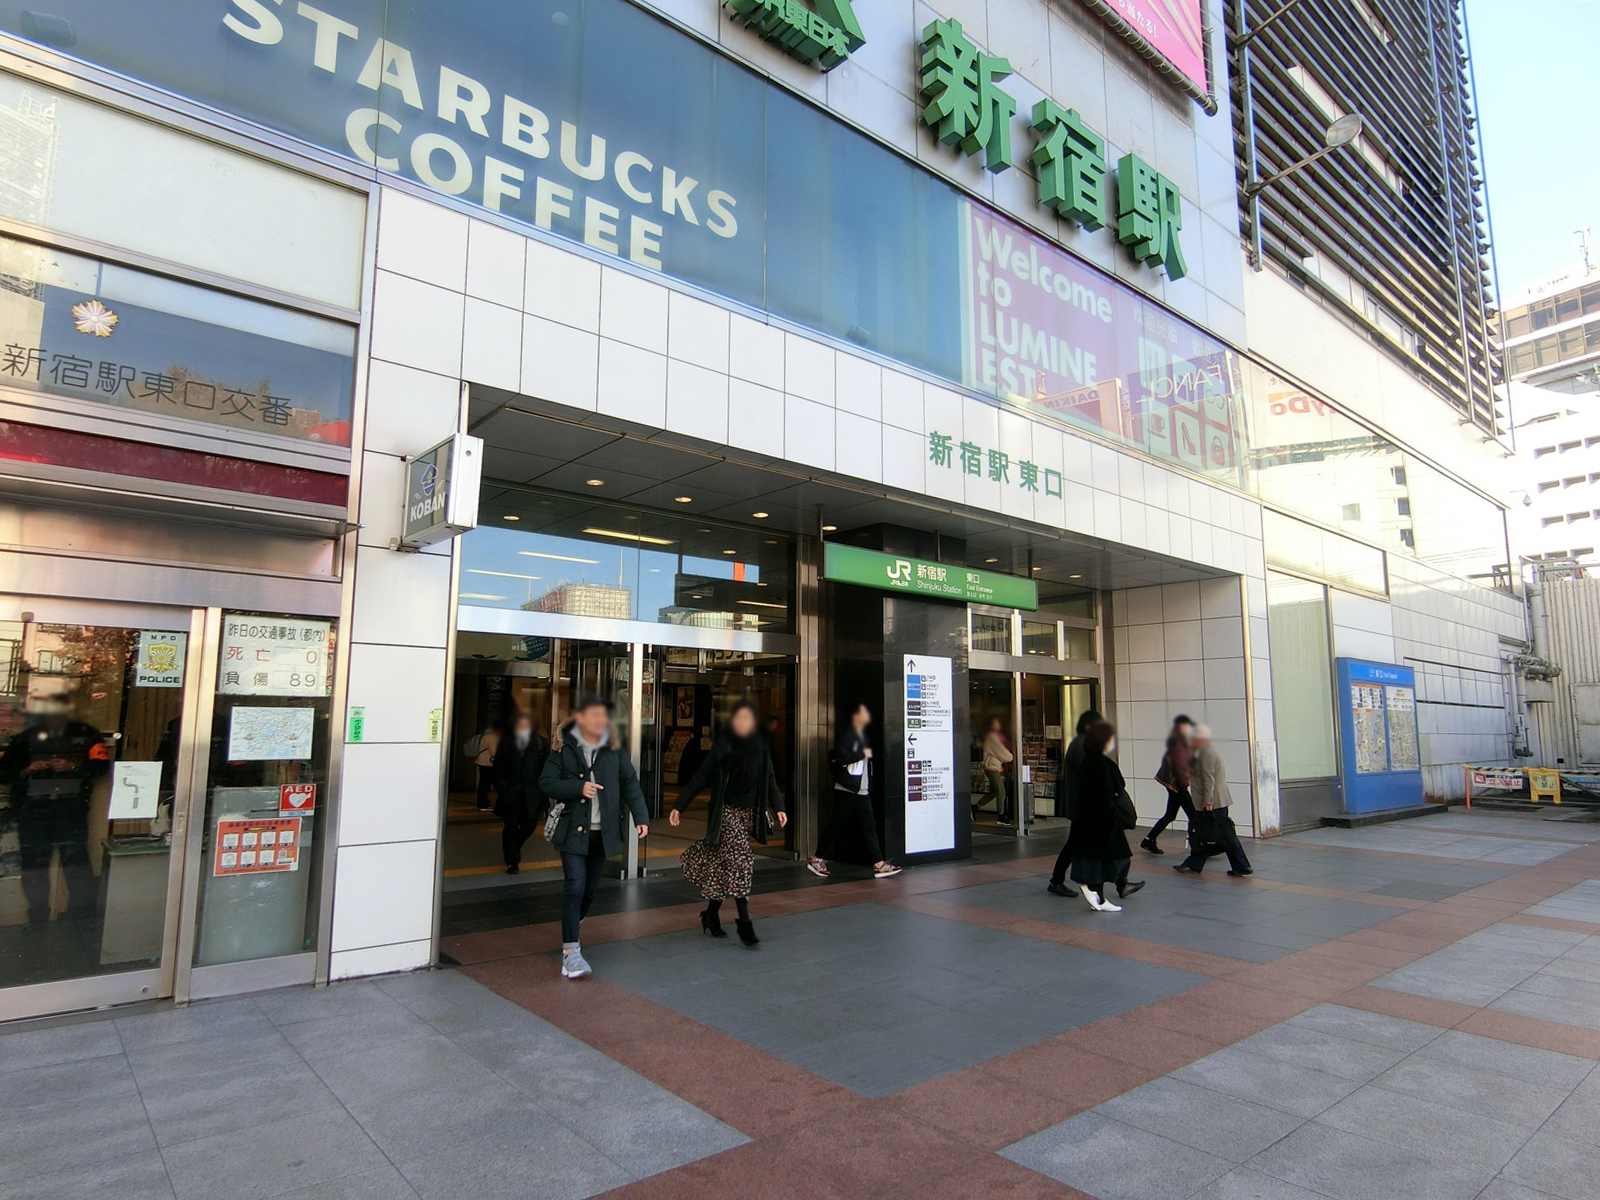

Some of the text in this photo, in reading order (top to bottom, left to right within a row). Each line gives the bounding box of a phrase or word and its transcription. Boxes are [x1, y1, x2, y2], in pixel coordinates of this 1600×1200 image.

[222, 0, 739, 239] STARBUCKS
[921, 17, 1188, 282] 新宿駅
[345, 108, 663, 270] COFFEE
[975, 217, 1112, 323] Welcome
[977, 264, 1012, 308] to
[981, 311, 1097, 386] LUMINE
[1, 342, 293, 426] 新宿駅東口交番
[982, 350, 1037, 401] EST
[410, 492, 446, 522] KOBAN
[886, 559, 912, 581] JR
[917, 564, 980, 584] 新宿駅 東口
[917, 580, 963, 595] Shinjuku Station
[306, 650, 318, 664] 0
[138, 674, 181, 685] POLICE
[290, 673, 316, 687] 89
[284, 785, 313, 794] AED
